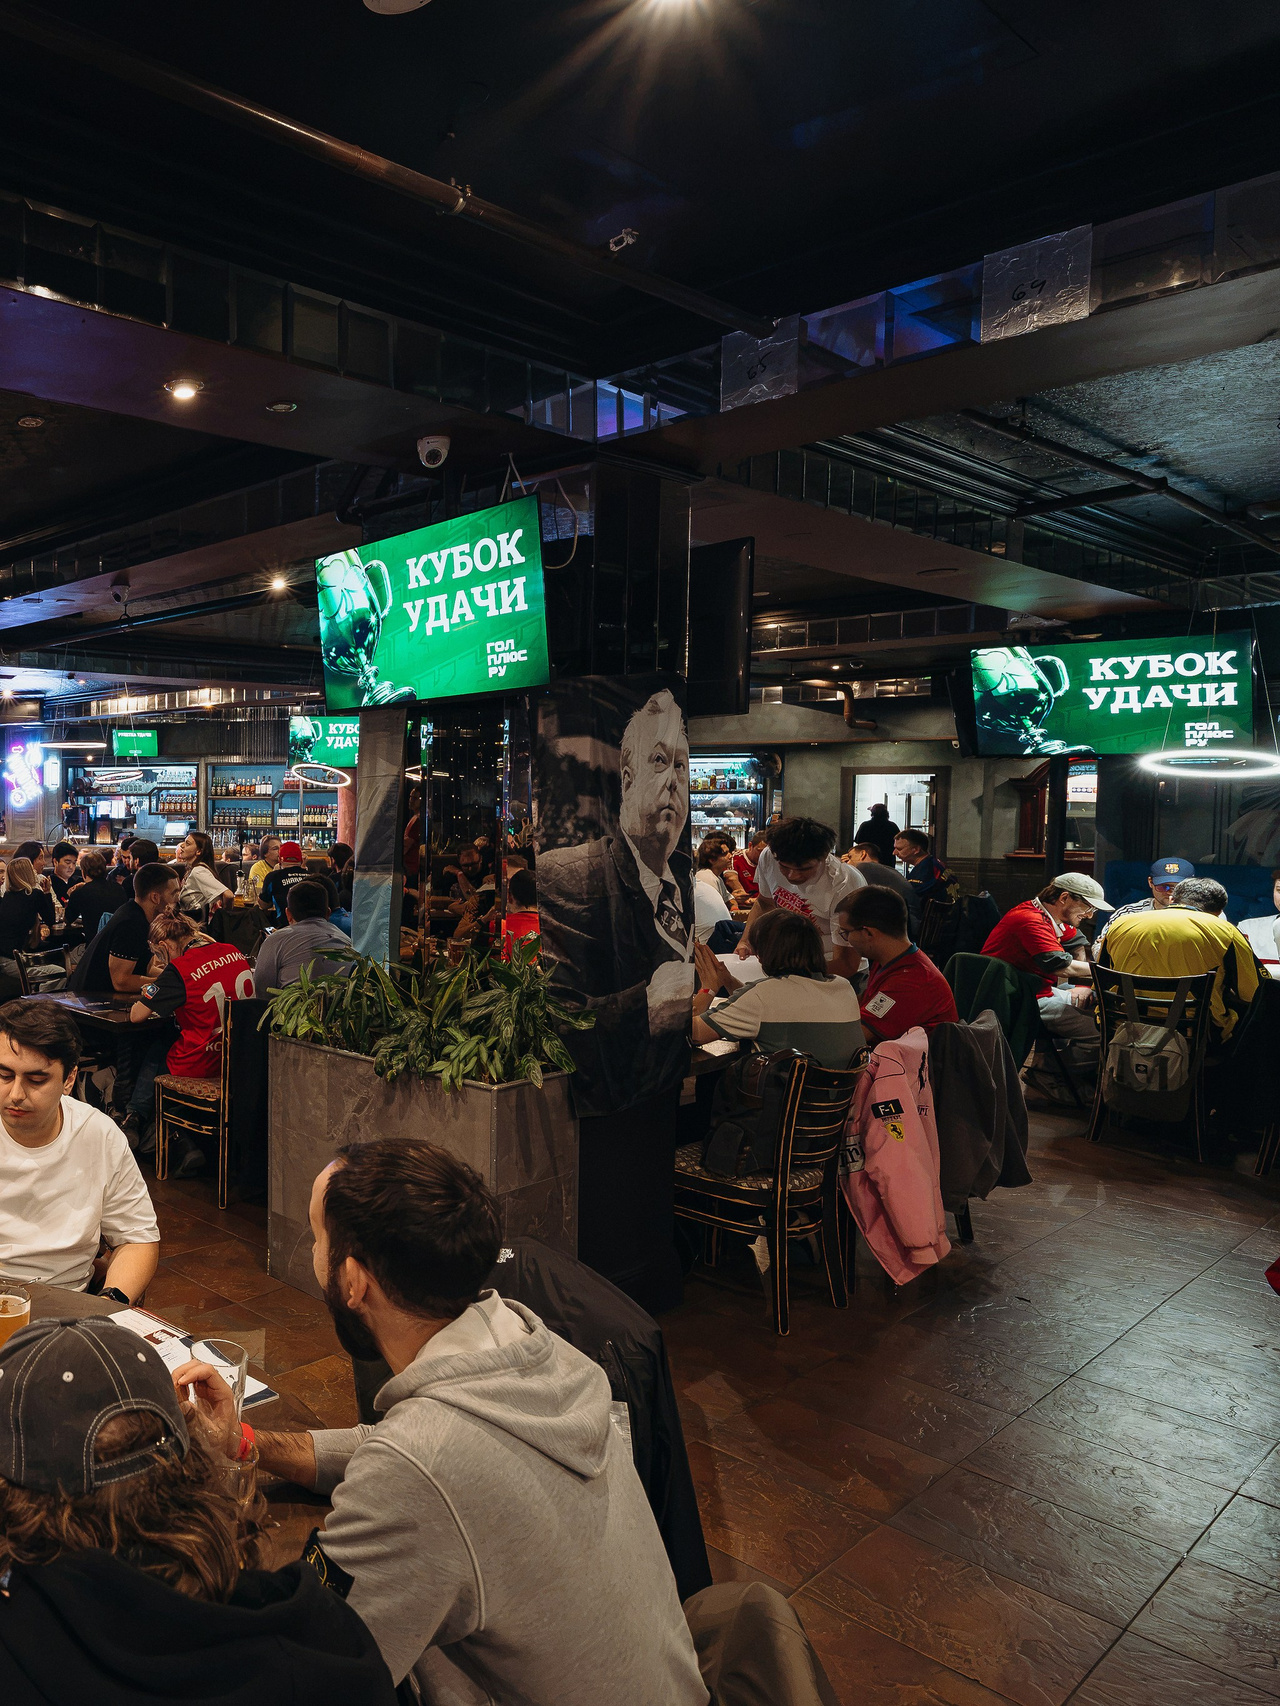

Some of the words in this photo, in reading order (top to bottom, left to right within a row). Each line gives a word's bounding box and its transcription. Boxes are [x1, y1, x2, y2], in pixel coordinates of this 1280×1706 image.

[407, 529, 525, 589] КУБОК
[403, 576, 528, 636] УДАЧИ
[486, 639, 515, 653] ГОЛ
[487, 650, 528, 666] ПЛЮС
[488, 665, 507, 678] РУ
[1089, 650, 1238, 681] КУБОК
[1082, 682, 1238, 714] УДАЧИ
[1185, 722, 1220, 731] ГОЛ
[1185, 730, 1234, 739] ПЛЮС
[1185, 738, 1208, 747] РУ
[879, 1103, 896, 1116] F-1
